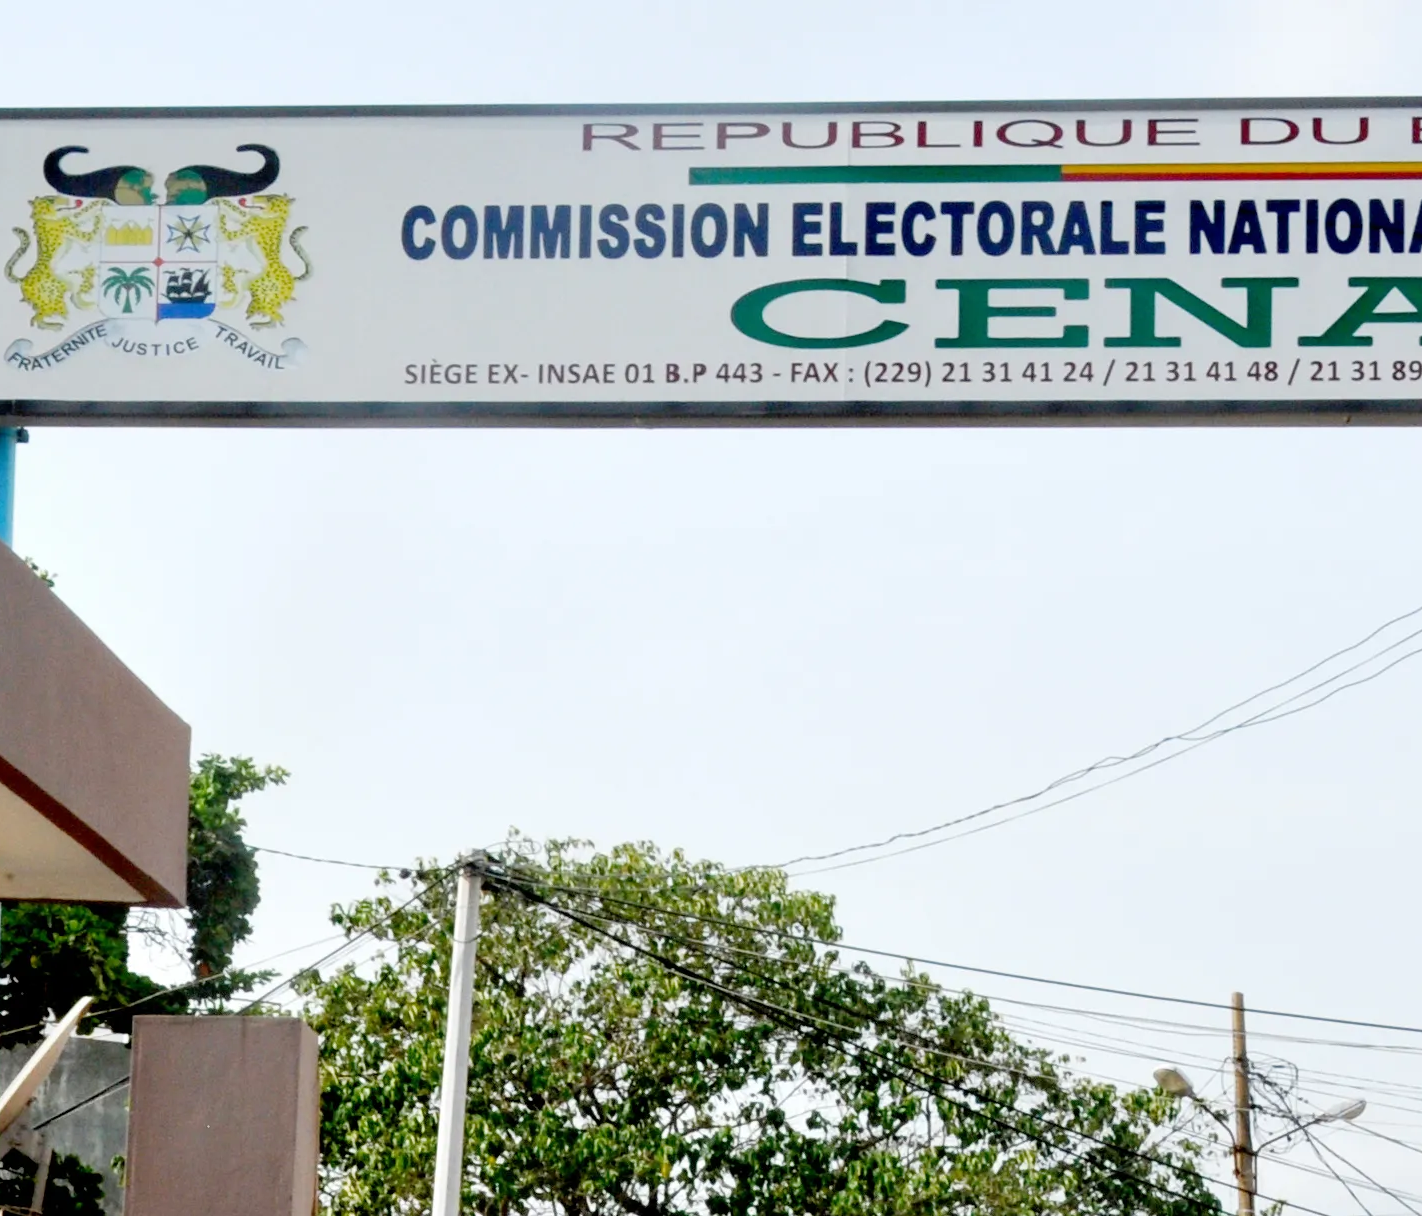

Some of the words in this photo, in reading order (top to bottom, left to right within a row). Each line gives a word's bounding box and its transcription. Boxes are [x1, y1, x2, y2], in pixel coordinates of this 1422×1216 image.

[582, 118, 1201, 151] REPUBLIQUE
[1240, 116, 1371, 146] DU
[401, 202, 769, 261] COMMISSION
[792, 200, 1167, 257] ELECTORALE
[7, 323, 108, 371] FRATERNITE
[111, 336, 200, 357] JUSTICE
[214, 325, 285, 370] TRAVAIL
[404, 358, 478, 385] SIÈGE
[487, 363, 529, 385] EX-
[538, 363, 616, 384] INSAE
[624, 363, 655, 384] 01
[665, 363, 707, 384] B.P
[715, 362, 764, 384] 443
[790, 362, 839, 383] FAX
[864, 360, 932, 389] (229)
[941, 361, 972, 383] 21
[982, 361, 1013, 383] 31
[1021, 361, 1053, 383] 41
[1062, 361, 1094, 383] 24
[1125, 361, 1156, 382] 21
[1166, 361, 1197, 382] 31
[1205, 361, 1237, 382] 41
[1246, 360, 1279, 382] 48
[1310, 360, 1341, 382] 21
[1351, 360, 1382, 382] 31
